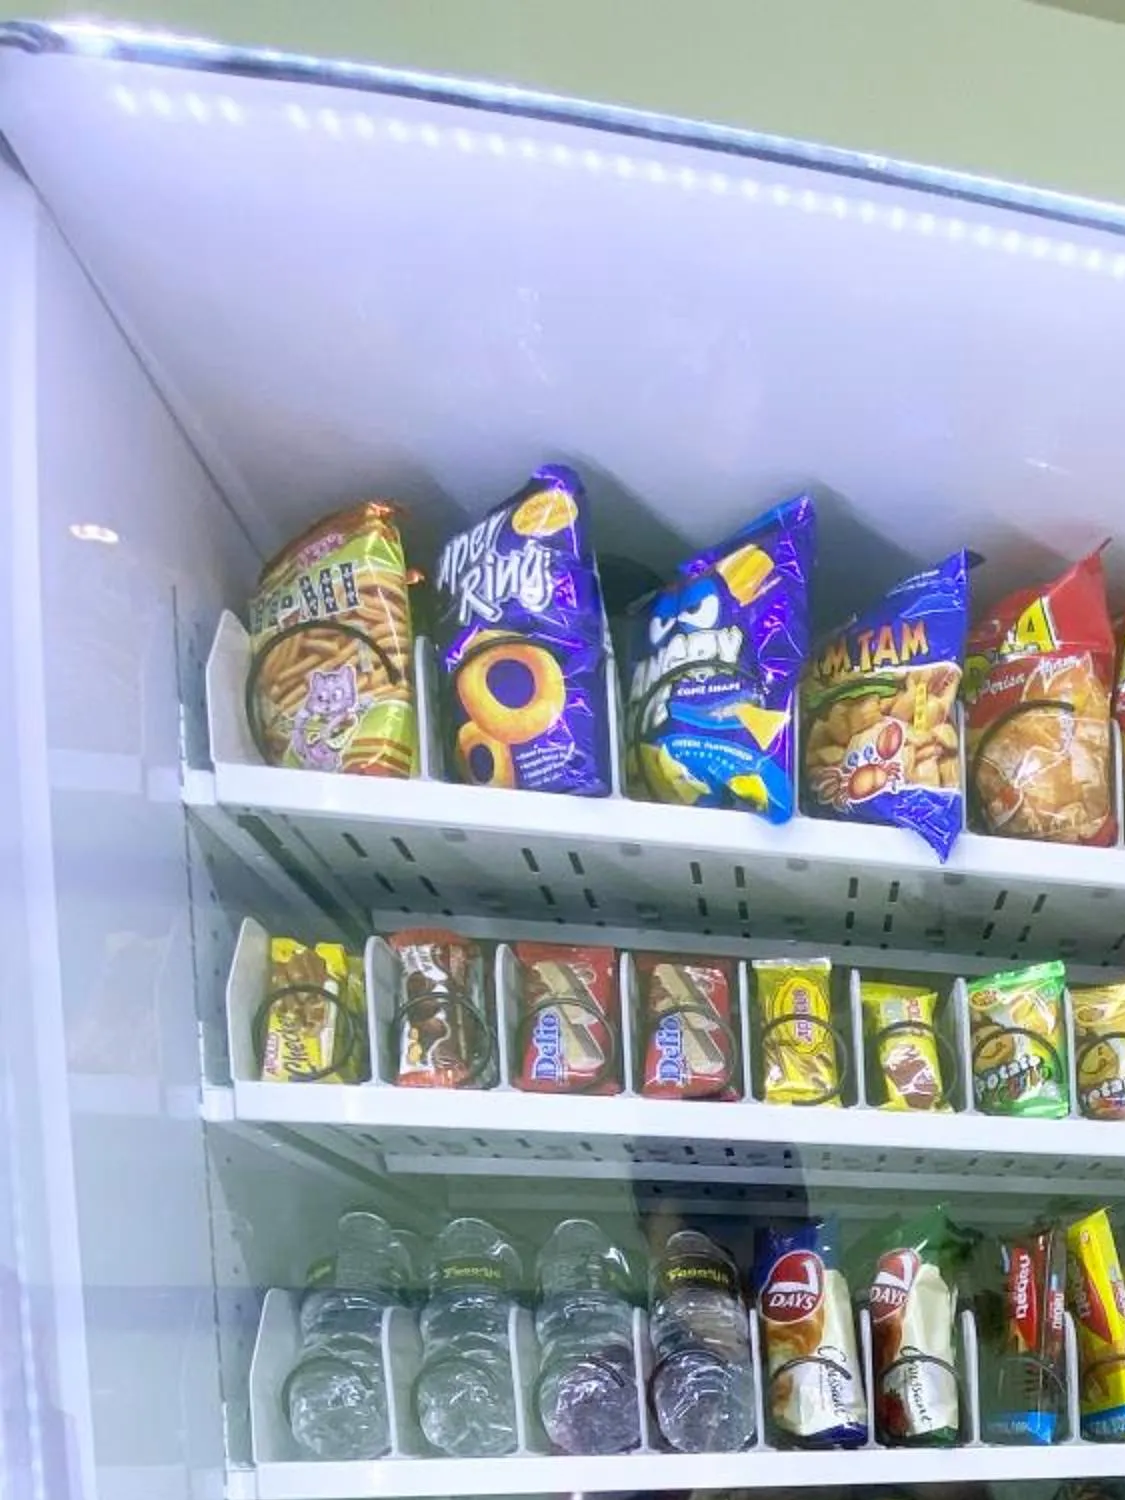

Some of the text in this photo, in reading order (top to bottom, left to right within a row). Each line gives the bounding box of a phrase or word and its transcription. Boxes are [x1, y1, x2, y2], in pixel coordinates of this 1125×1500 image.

[857, 617, 929, 673] TAM
[769, 1293, 817, 1311] DAYS
[870, 1285, 909, 1307] DAYS
